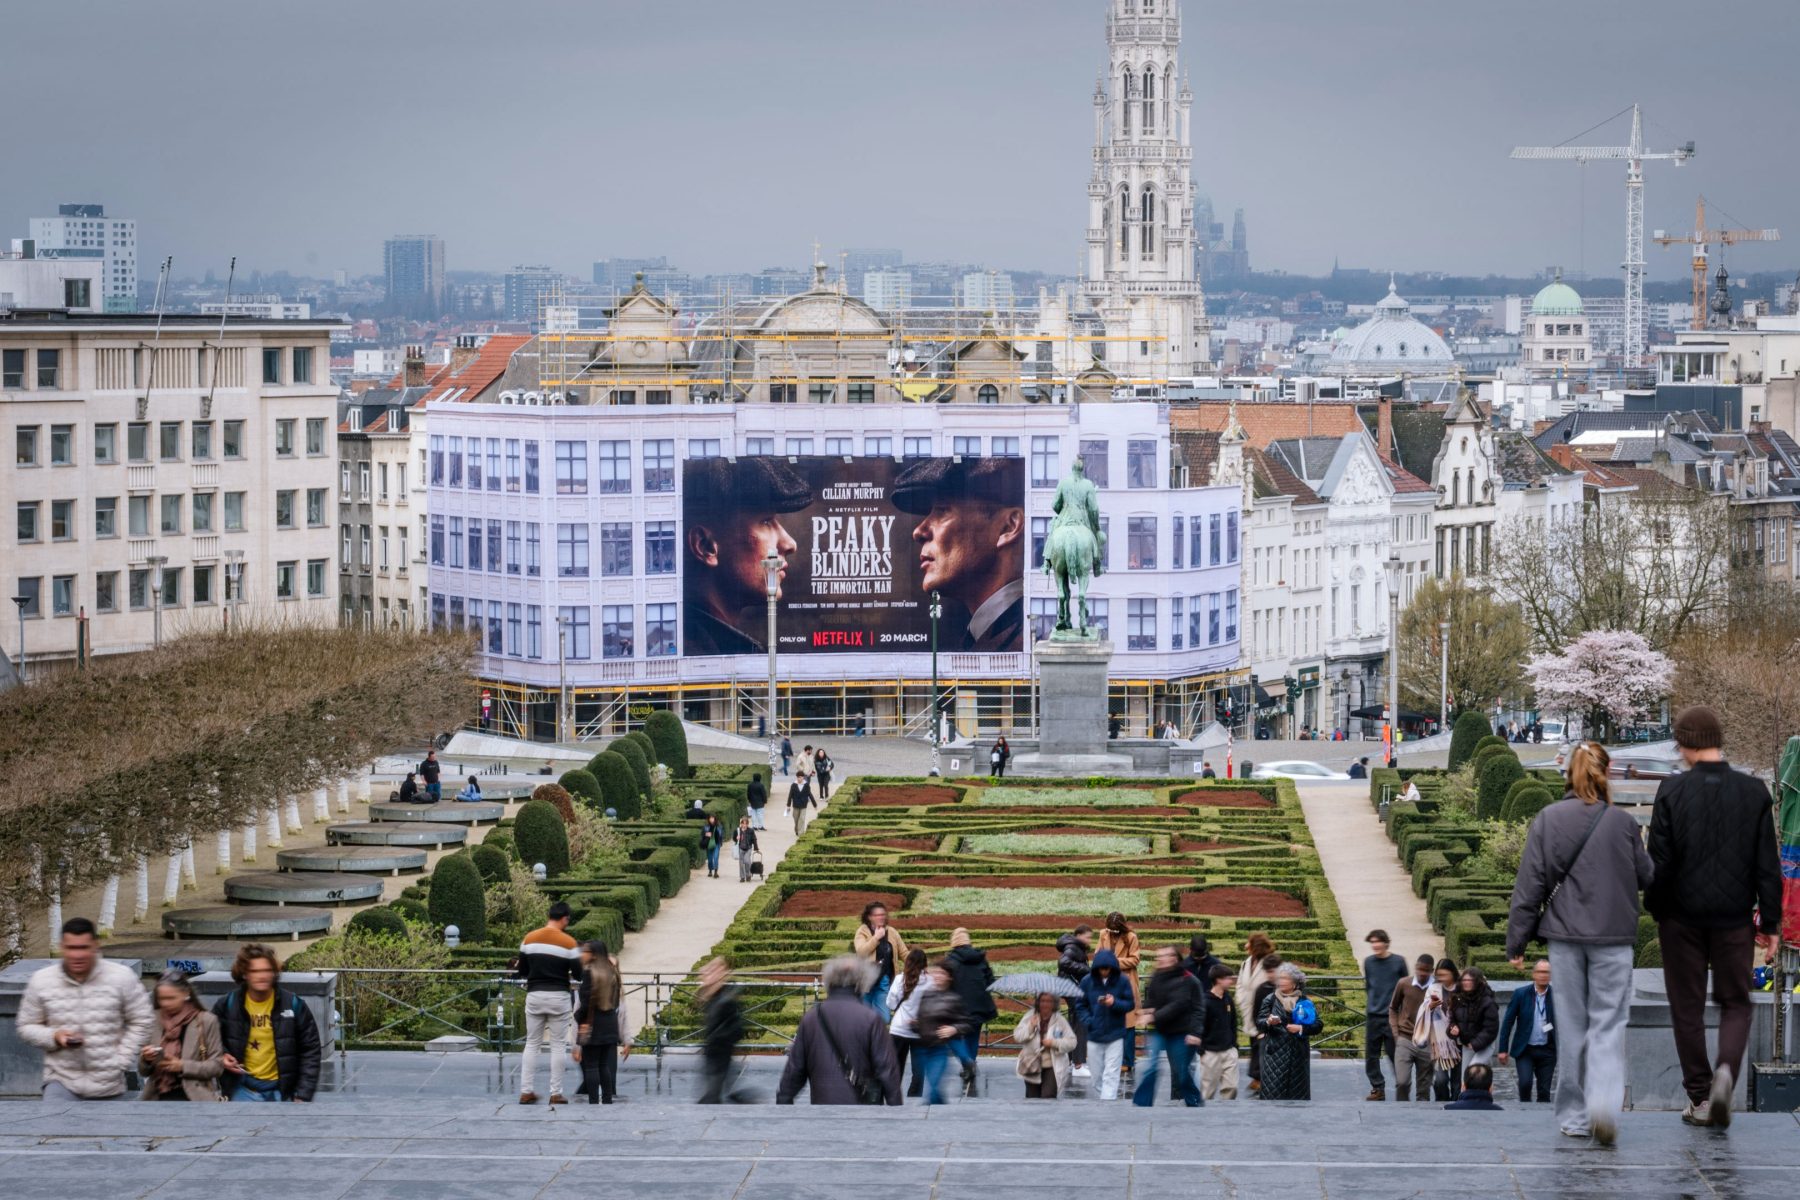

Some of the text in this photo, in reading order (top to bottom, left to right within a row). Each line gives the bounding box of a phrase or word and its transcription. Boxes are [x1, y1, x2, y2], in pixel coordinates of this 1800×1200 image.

[822, 487, 885, 500] CILLIAN MURPHY
[811, 516, 896, 552] PEAKY
[811, 552, 893, 577] BLINDERS
[811, 580, 892, 595] THE IMMORTAL MAN
[813, 631, 863, 646] NETFLIX
[880, 634, 892, 642] 20
[893, 634, 928, 642] MARCH
